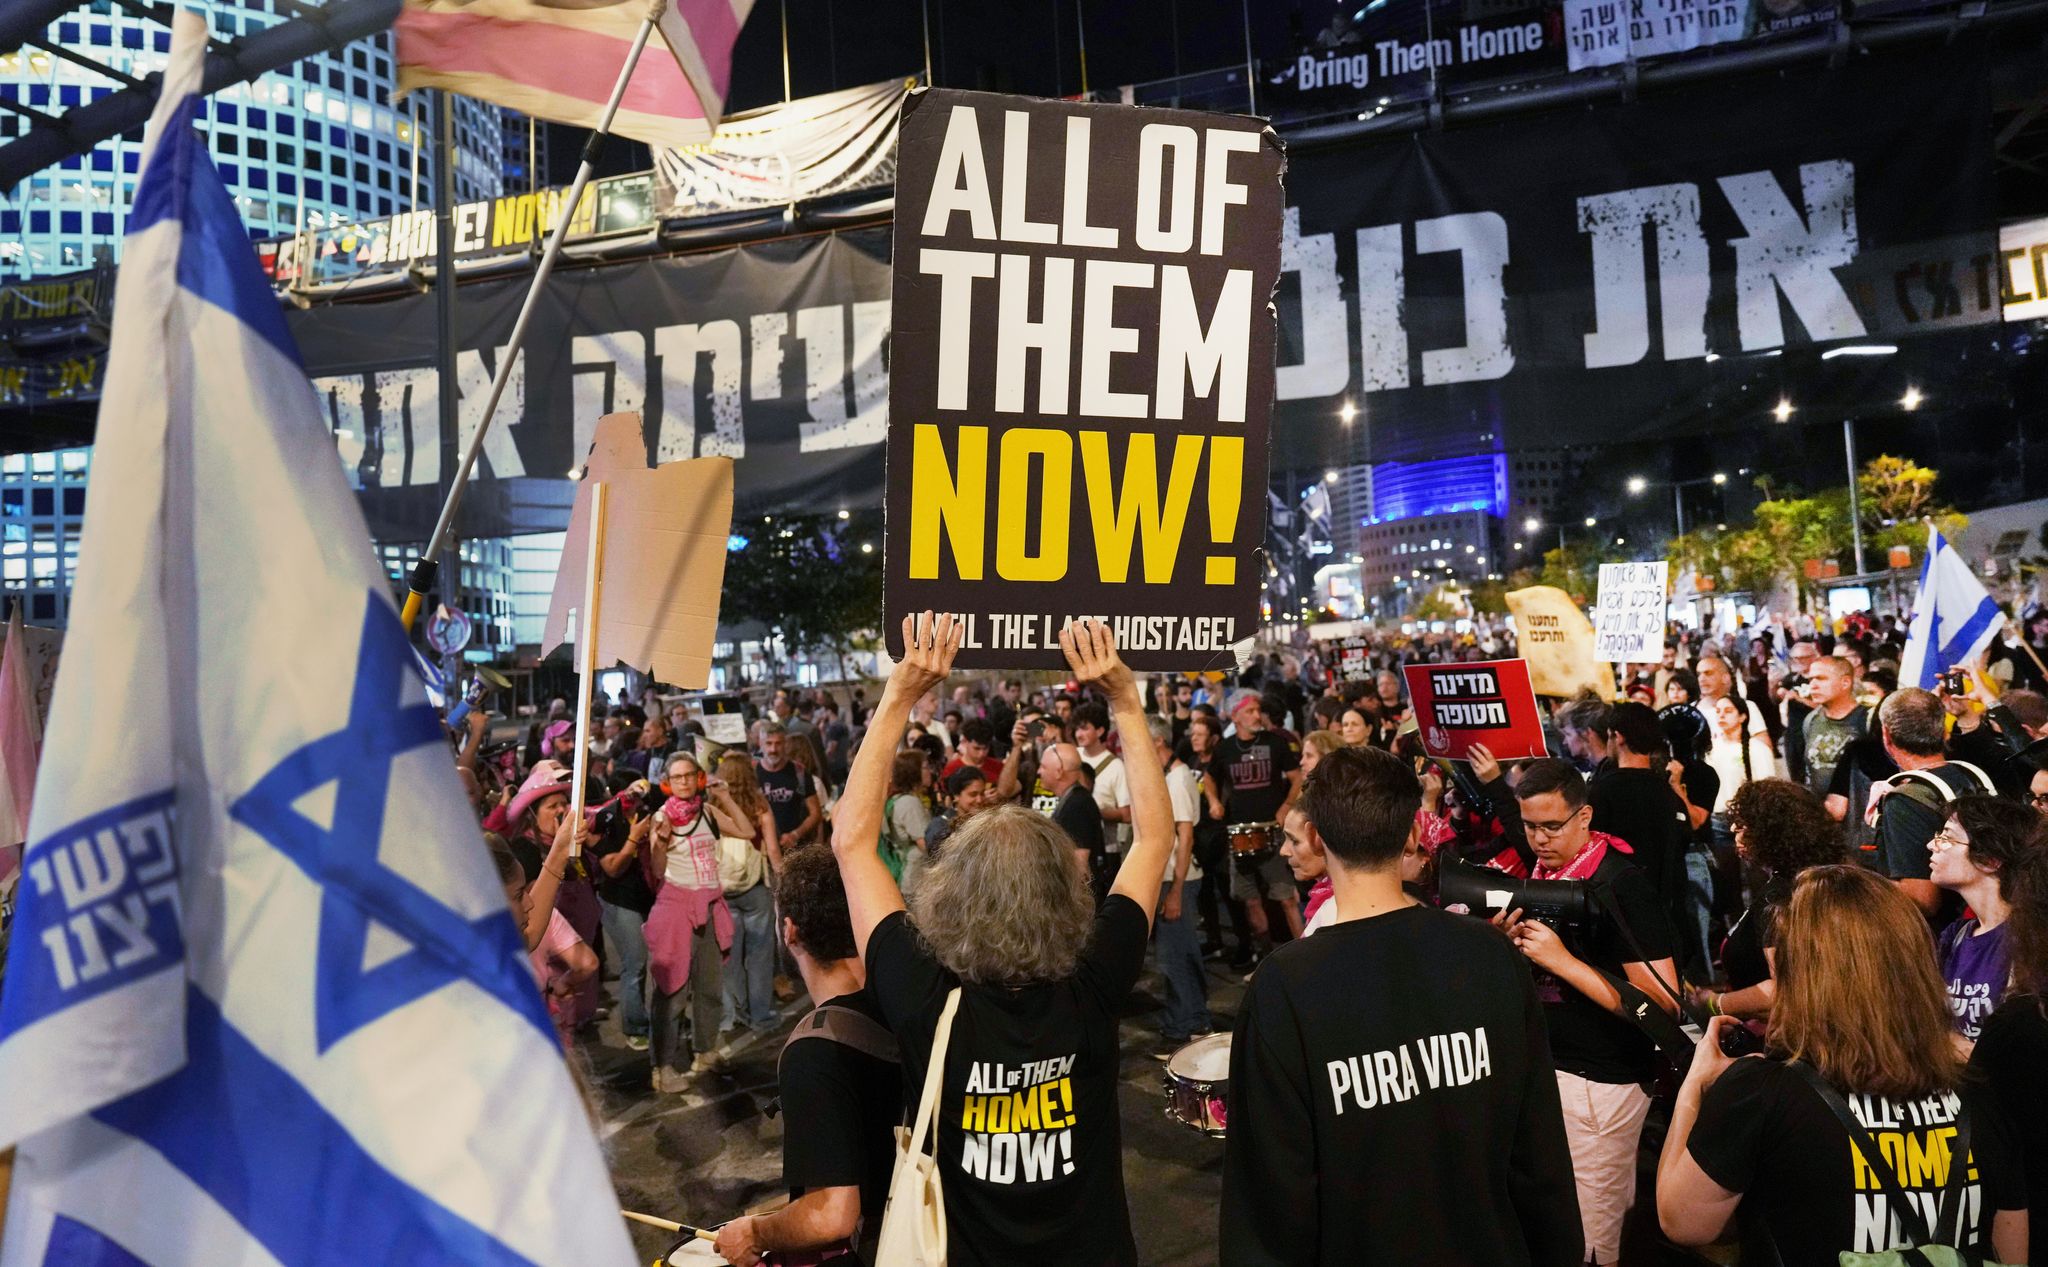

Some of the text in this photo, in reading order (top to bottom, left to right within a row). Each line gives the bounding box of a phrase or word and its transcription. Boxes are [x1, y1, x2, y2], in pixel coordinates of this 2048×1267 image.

[1298, 22, 1544, 91] Bring Them Home
[1572, 27, 1619, 52] אותי
[1664, 5, 1738, 36] תחזירו
[921, 105, 1119, 248] ALL
[1136, 123, 1260, 256] OF
[1276, 206, 1516, 401] כול
[1577, 159, 1868, 369] את
[919, 248, 1253, 422] THEM
[572, 300, 892, 476] עימה
[909, 423, 1244, 585] NOW!
[988, 613, 1039, 649] THE
[1115, 615, 1236, 651] HOSTAGE!
[1433, 672, 1497, 696] מדינה
[1436, 702, 1507, 725] חטופה
[29, 811, 175, 911] פשי
[42, 882, 182, 991] רצנו
[962, 1077, 1077, 1133] HOME!
[965, 1053, 1077, 1094] ALL OF THEM
[1326, 1026, 1492, 1116] PURA VIDA
[961, 1128, 1076, 1185] NOW!
